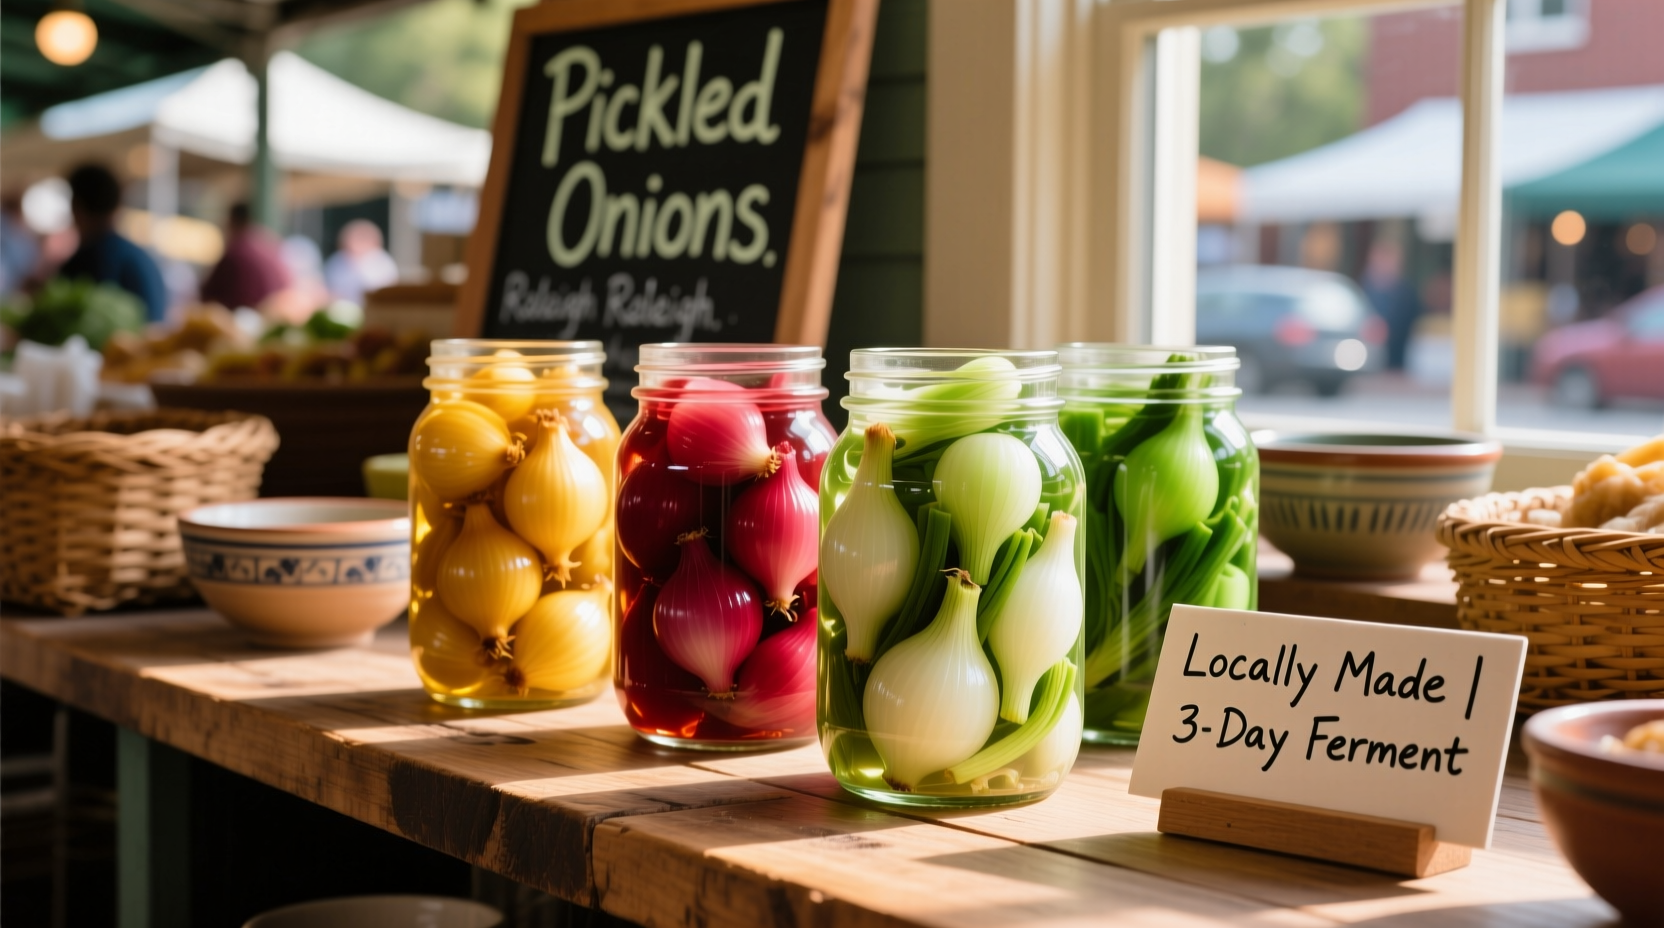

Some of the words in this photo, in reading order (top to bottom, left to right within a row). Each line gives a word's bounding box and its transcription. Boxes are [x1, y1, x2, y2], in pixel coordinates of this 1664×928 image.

[542, 27, 783, 168] Pickled
[546, 161, 777, 268] Onions.
[1182, 632, 1318, 708] Locally
[1333, 650, 1446, 702] Made
[1172, 703, 1290, 772] 3-Day
[1305, 715, 1469, 776] Ferment
